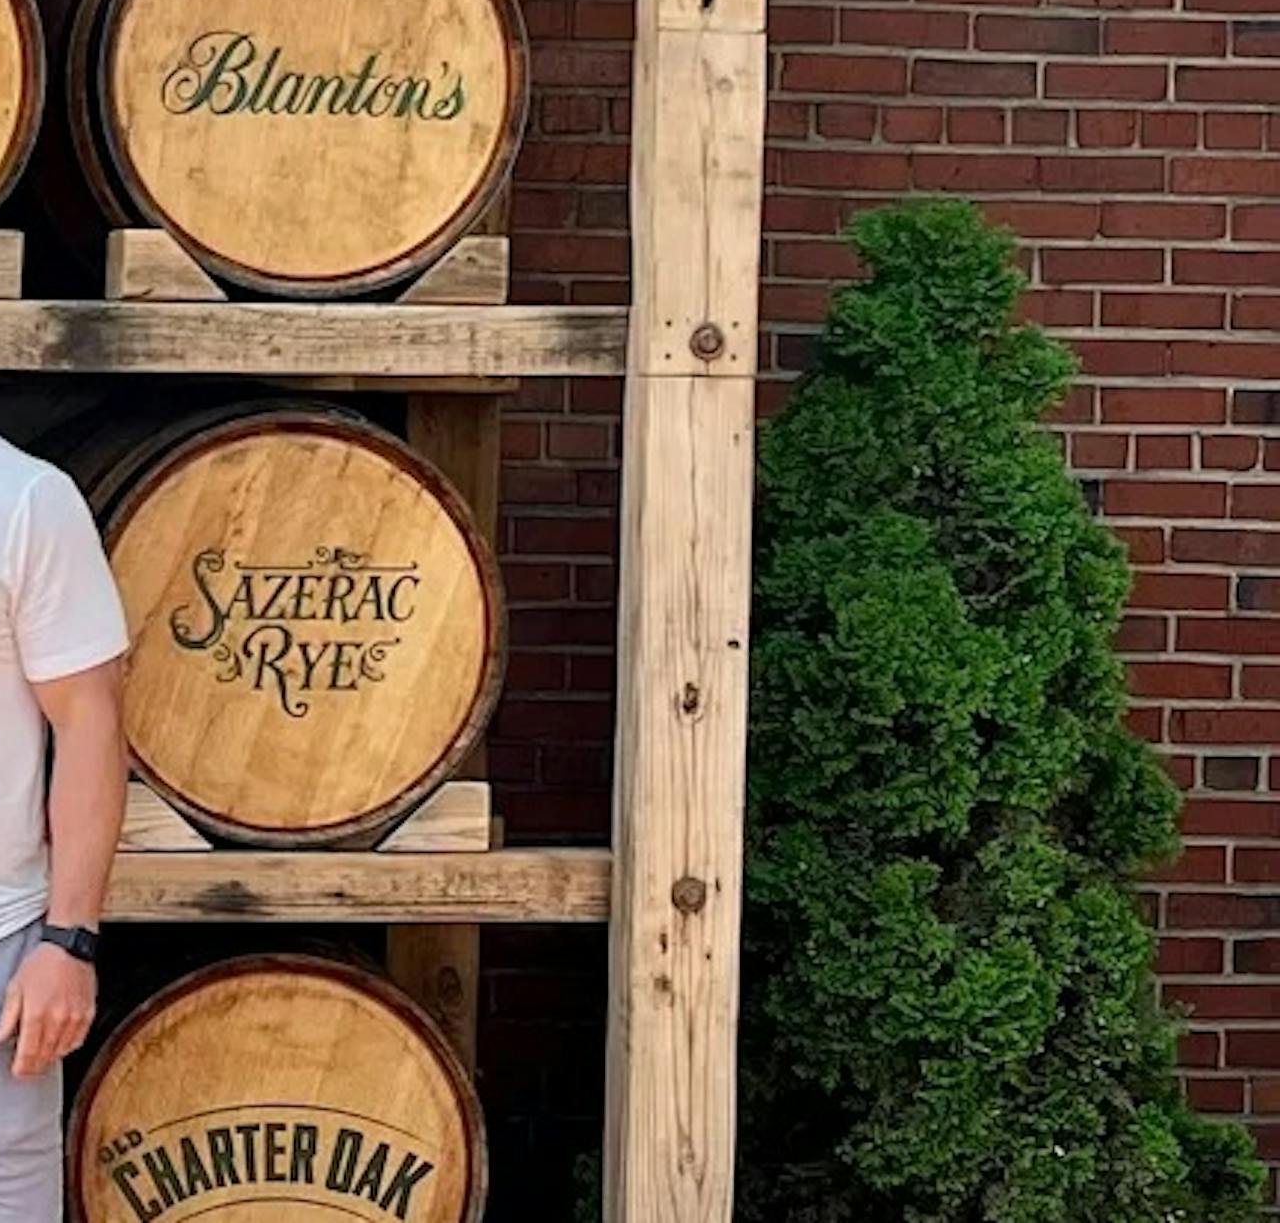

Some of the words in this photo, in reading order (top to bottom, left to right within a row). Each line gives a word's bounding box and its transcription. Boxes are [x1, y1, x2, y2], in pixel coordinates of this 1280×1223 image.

[160, 30, 462, 120] Blanton's
[169, 547, 421, 651] SAZERAC
[242, 624, 364, 718] RYE
[101, 1128, 143, 1164] OLD
[111, 1122, 319, 1223] CHARTER
[325, 1127, 435, 1220] OAK
